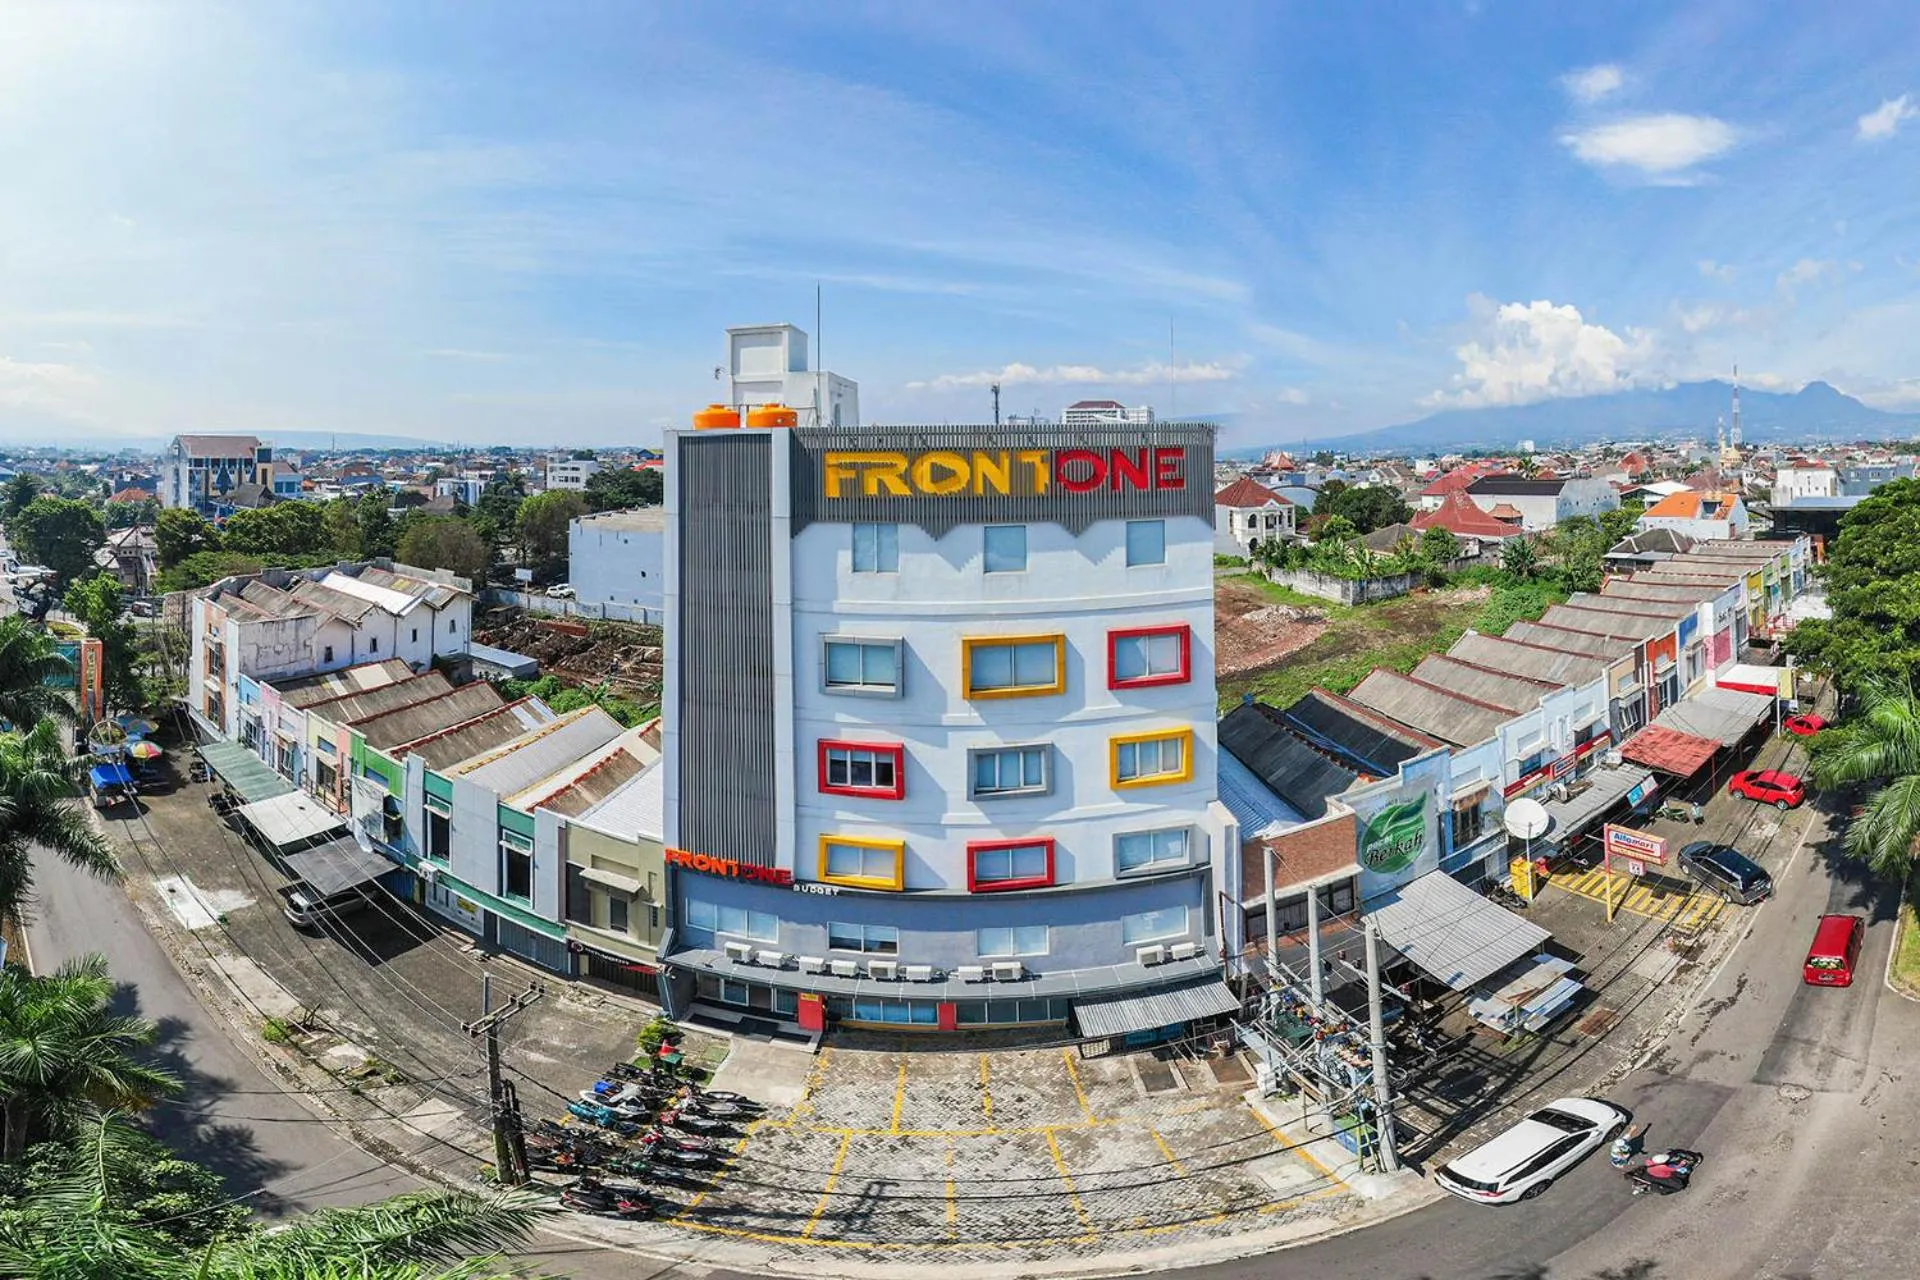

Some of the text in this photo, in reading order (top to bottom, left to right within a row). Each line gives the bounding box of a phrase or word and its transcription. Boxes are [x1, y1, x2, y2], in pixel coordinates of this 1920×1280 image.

[1364, 827, 1424, 865] Berkah
[1613, 832, 1655, 849] Alfamart
[793, 883, 840, 896] BUDGET
